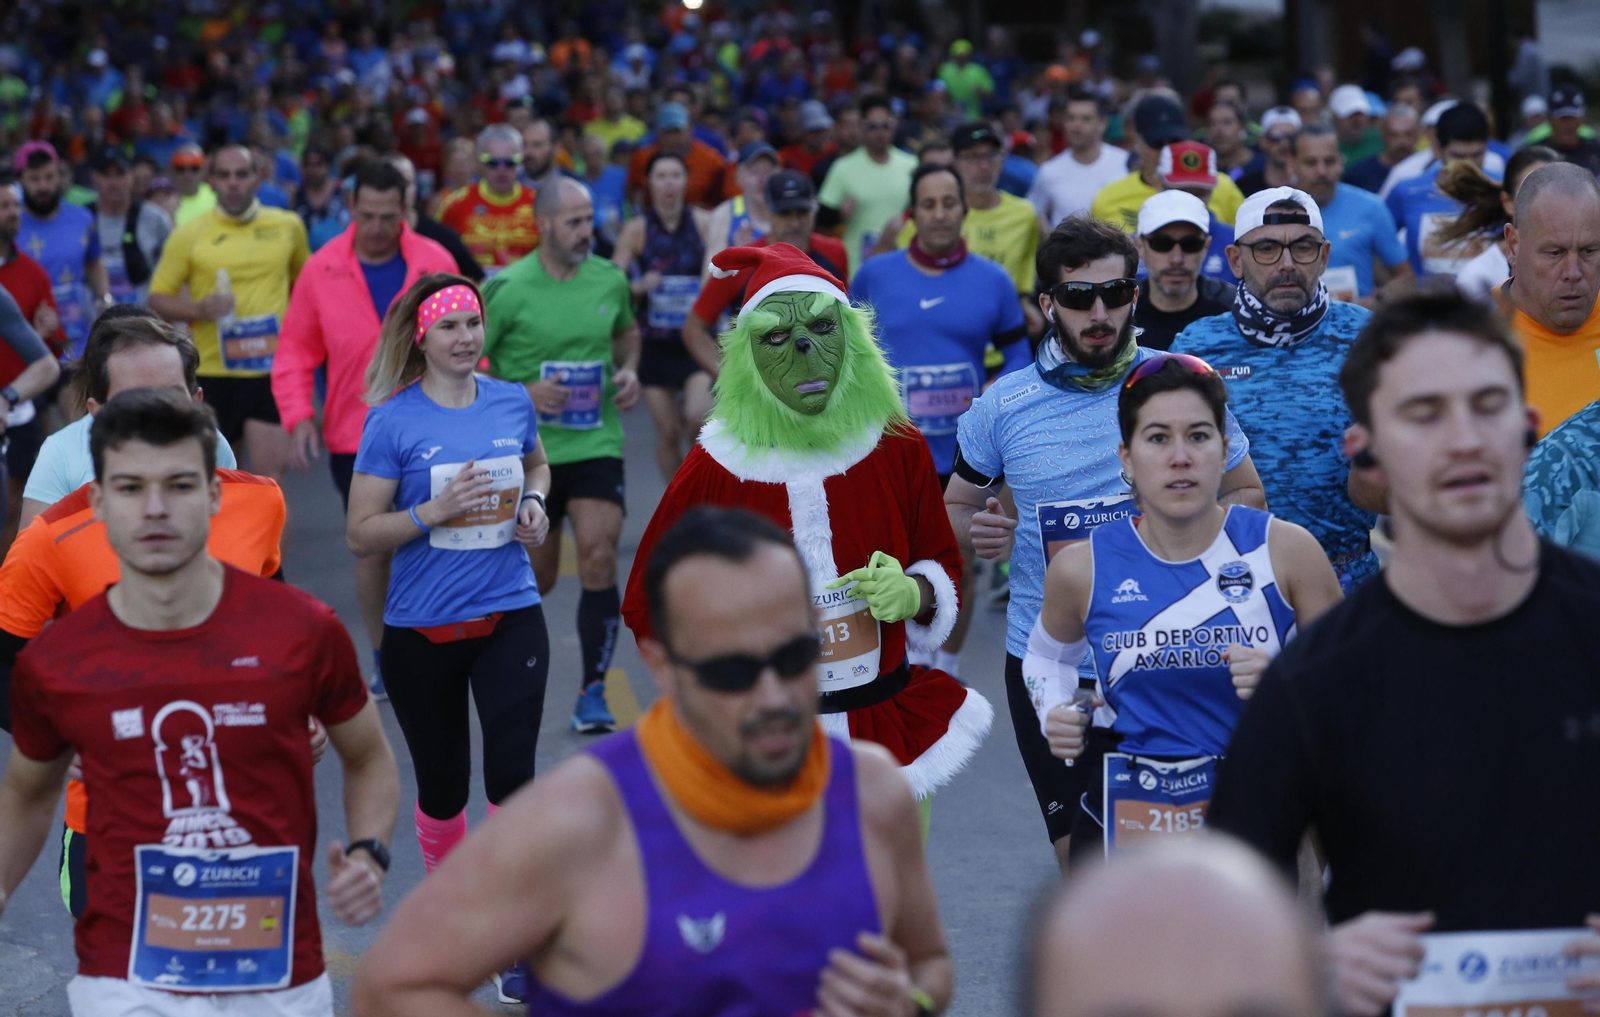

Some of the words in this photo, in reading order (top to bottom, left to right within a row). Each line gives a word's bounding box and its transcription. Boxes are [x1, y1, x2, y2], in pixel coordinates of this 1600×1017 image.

[1003, 388, 1029, 403] luanvi
[1084, 510, 1129, 524] ZURICH
[813, 587, 860, 606] ZURIC
[820, 622, 850, 645] 13
[1103, 631, 1147, 652] CLUB
[1155, 626, 1269, 647] DEPORTIVO
[1149, 808, 1205, 833] 2185
[200, 867, 261, 882] ZURICH
[181, 904, 247, 931] 2275
